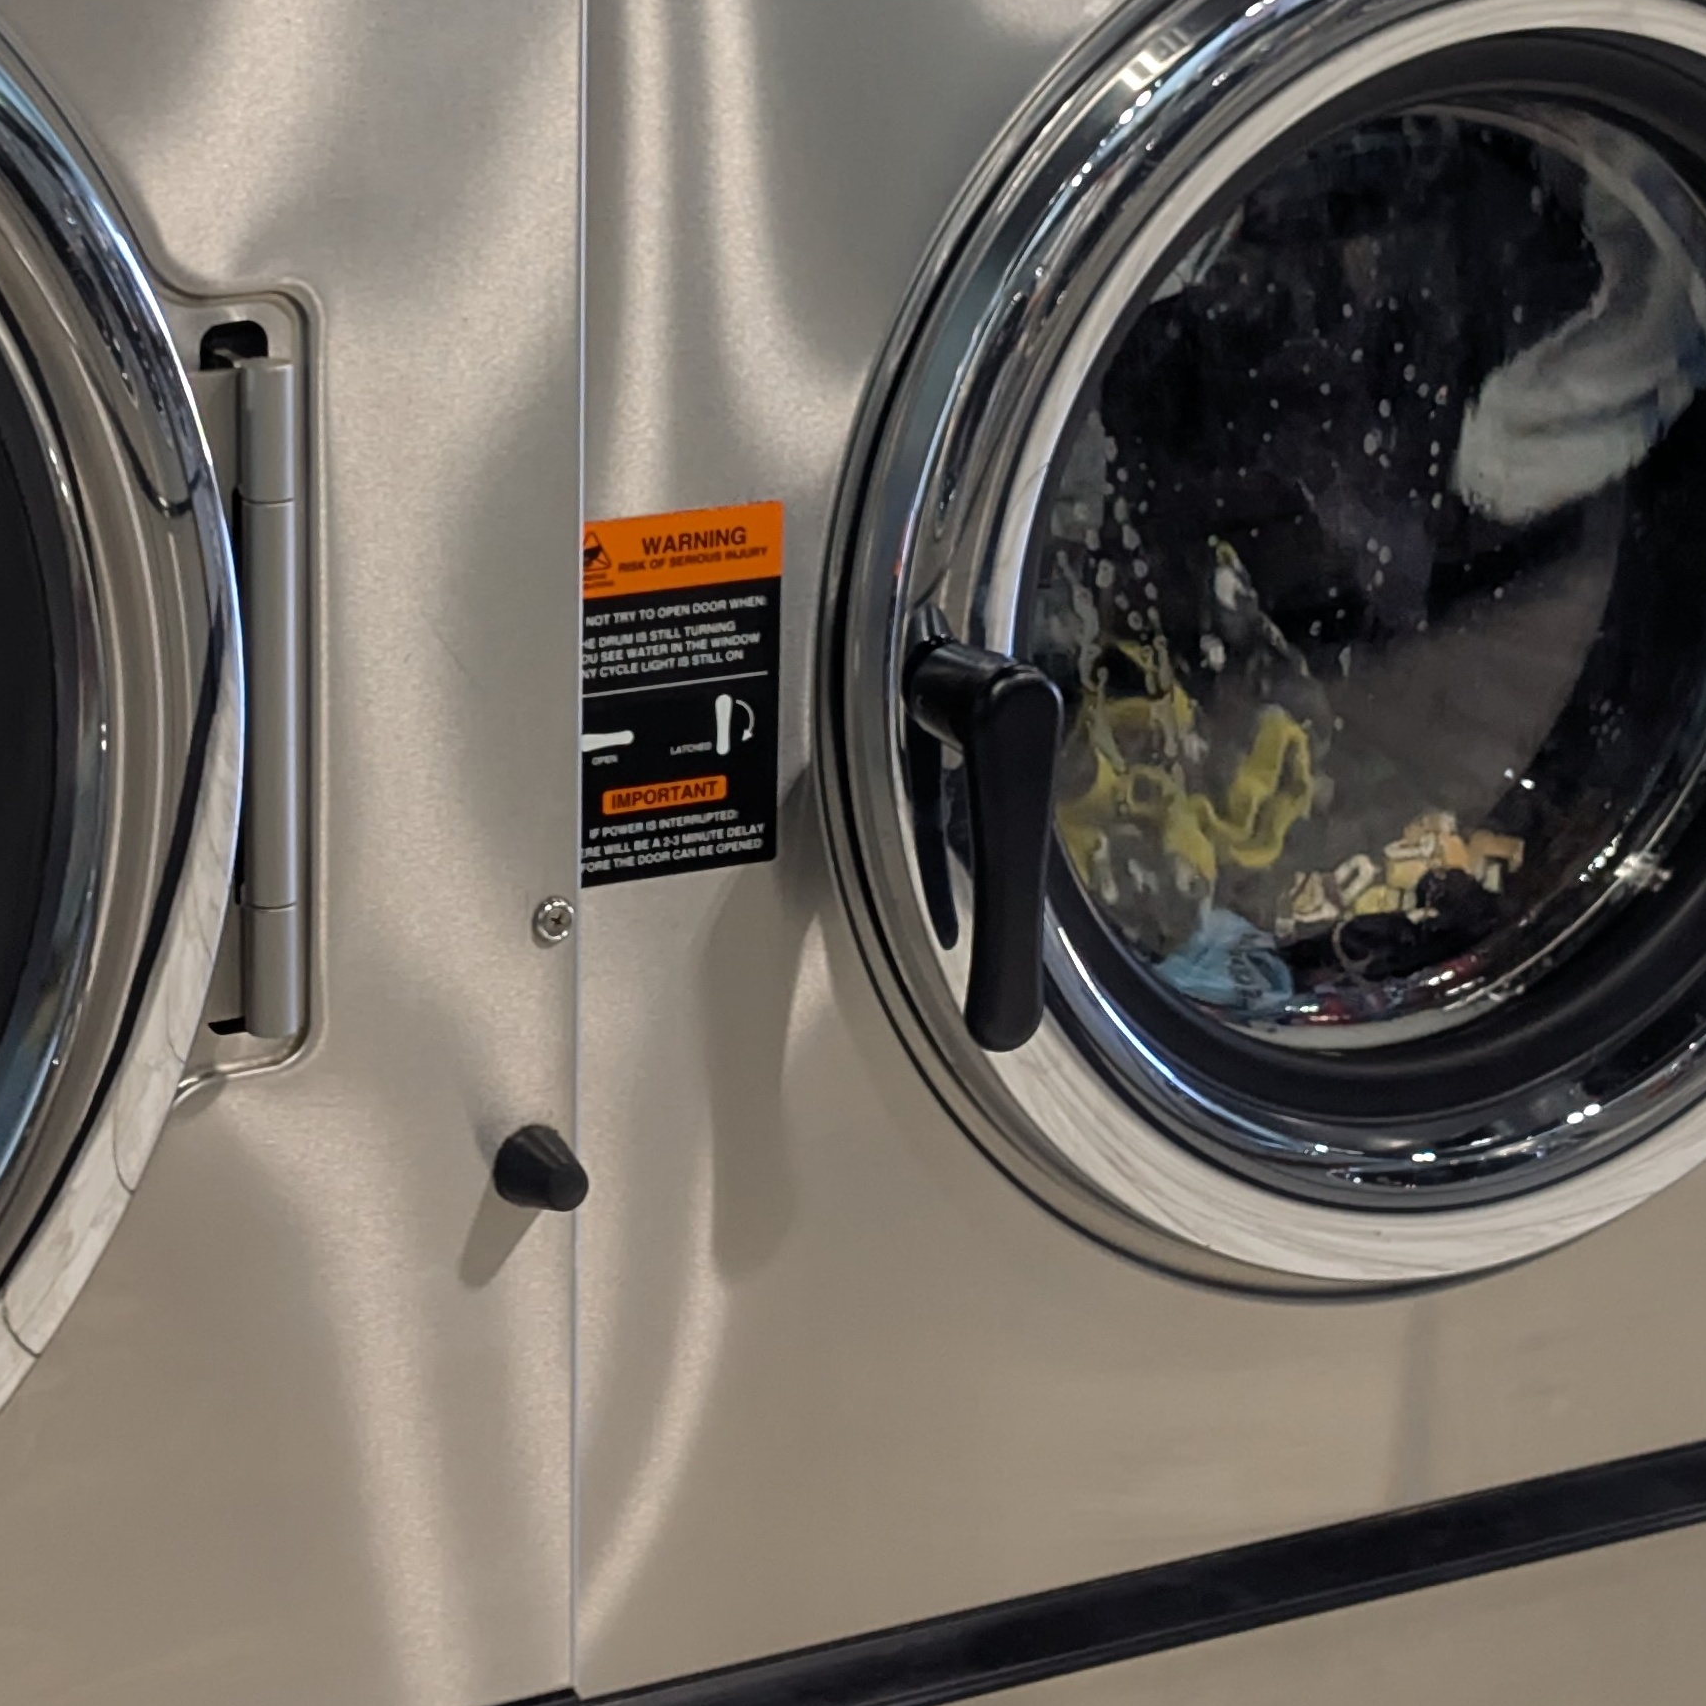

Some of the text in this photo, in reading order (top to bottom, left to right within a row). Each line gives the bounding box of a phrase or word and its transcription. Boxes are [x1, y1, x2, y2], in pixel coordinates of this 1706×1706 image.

[642, 526, 747, 555] WARNING
[618, 546, 768, 573] RISK OF SERIOUS INJURY
[585, 613, 610, 627] NOT
[613, 611, 636, 624] TRY
[639, 608, 655, 621] TO
[657, 604, 691, 619] OPEN
[693, 599, 727, 614] DOOR
[582, 632, 761, 666] OU SEE WATER IN THE WINDOW
[583, 620, 736, 649] HE DRUM IS STILL TURNING
[599, 661, 639, 678] CYCLE
[641, 657, 675, 672] LIGHT
[678, 655, 690, 667] IS
[692, 652, 723, 666] STILL
[725, 649, 744, 661] ON
[591, 754, 618, 767] OPEN
[611, 780, 718, 810] IMPORTANT
[589, 827, 601, 840] IF
[602, 822, 644, 837] POWER
[646, 820, 657, 831] IS
[604, 842, 631, 855] WILL
[634, 838, 650, 851] BE
[652, 836, 661, 847] A
[682, 828, 724, 843] MINUTE
[726, 822, 765, 837] DELAY
[614, 855, 635, 868] THE
[637, 851, 670, 866] DOOR
[672, 847, 697, 860] CAN
[699, 844, 714, 856] BE
[716, 838, 763, 853] OPENED
